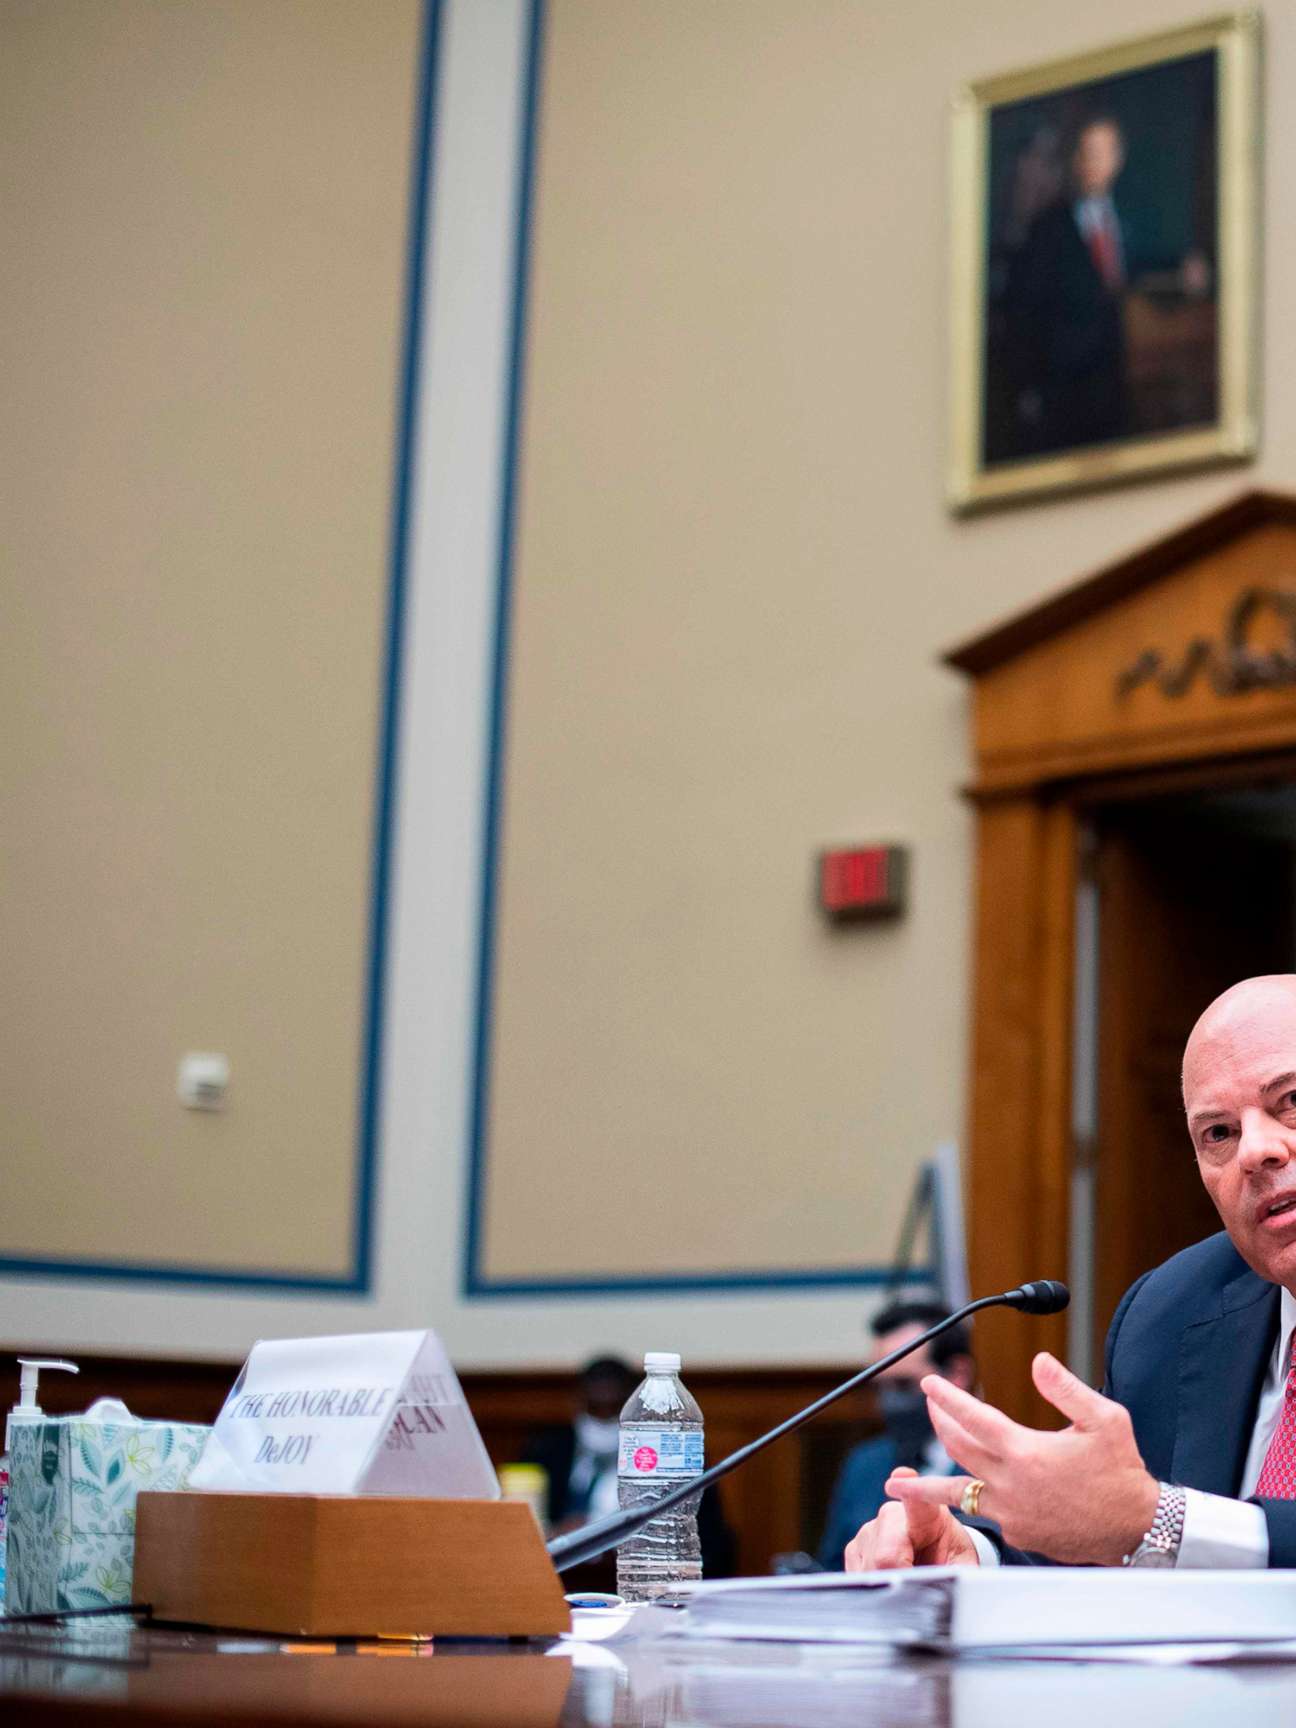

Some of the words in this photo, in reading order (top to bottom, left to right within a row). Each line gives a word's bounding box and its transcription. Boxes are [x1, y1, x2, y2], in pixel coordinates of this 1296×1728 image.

[229, 1392, 274, 1419] THE
[265, 1387, 393, 1419] HONORABLE
[254, 1433, 319, 1465] DeJOY
